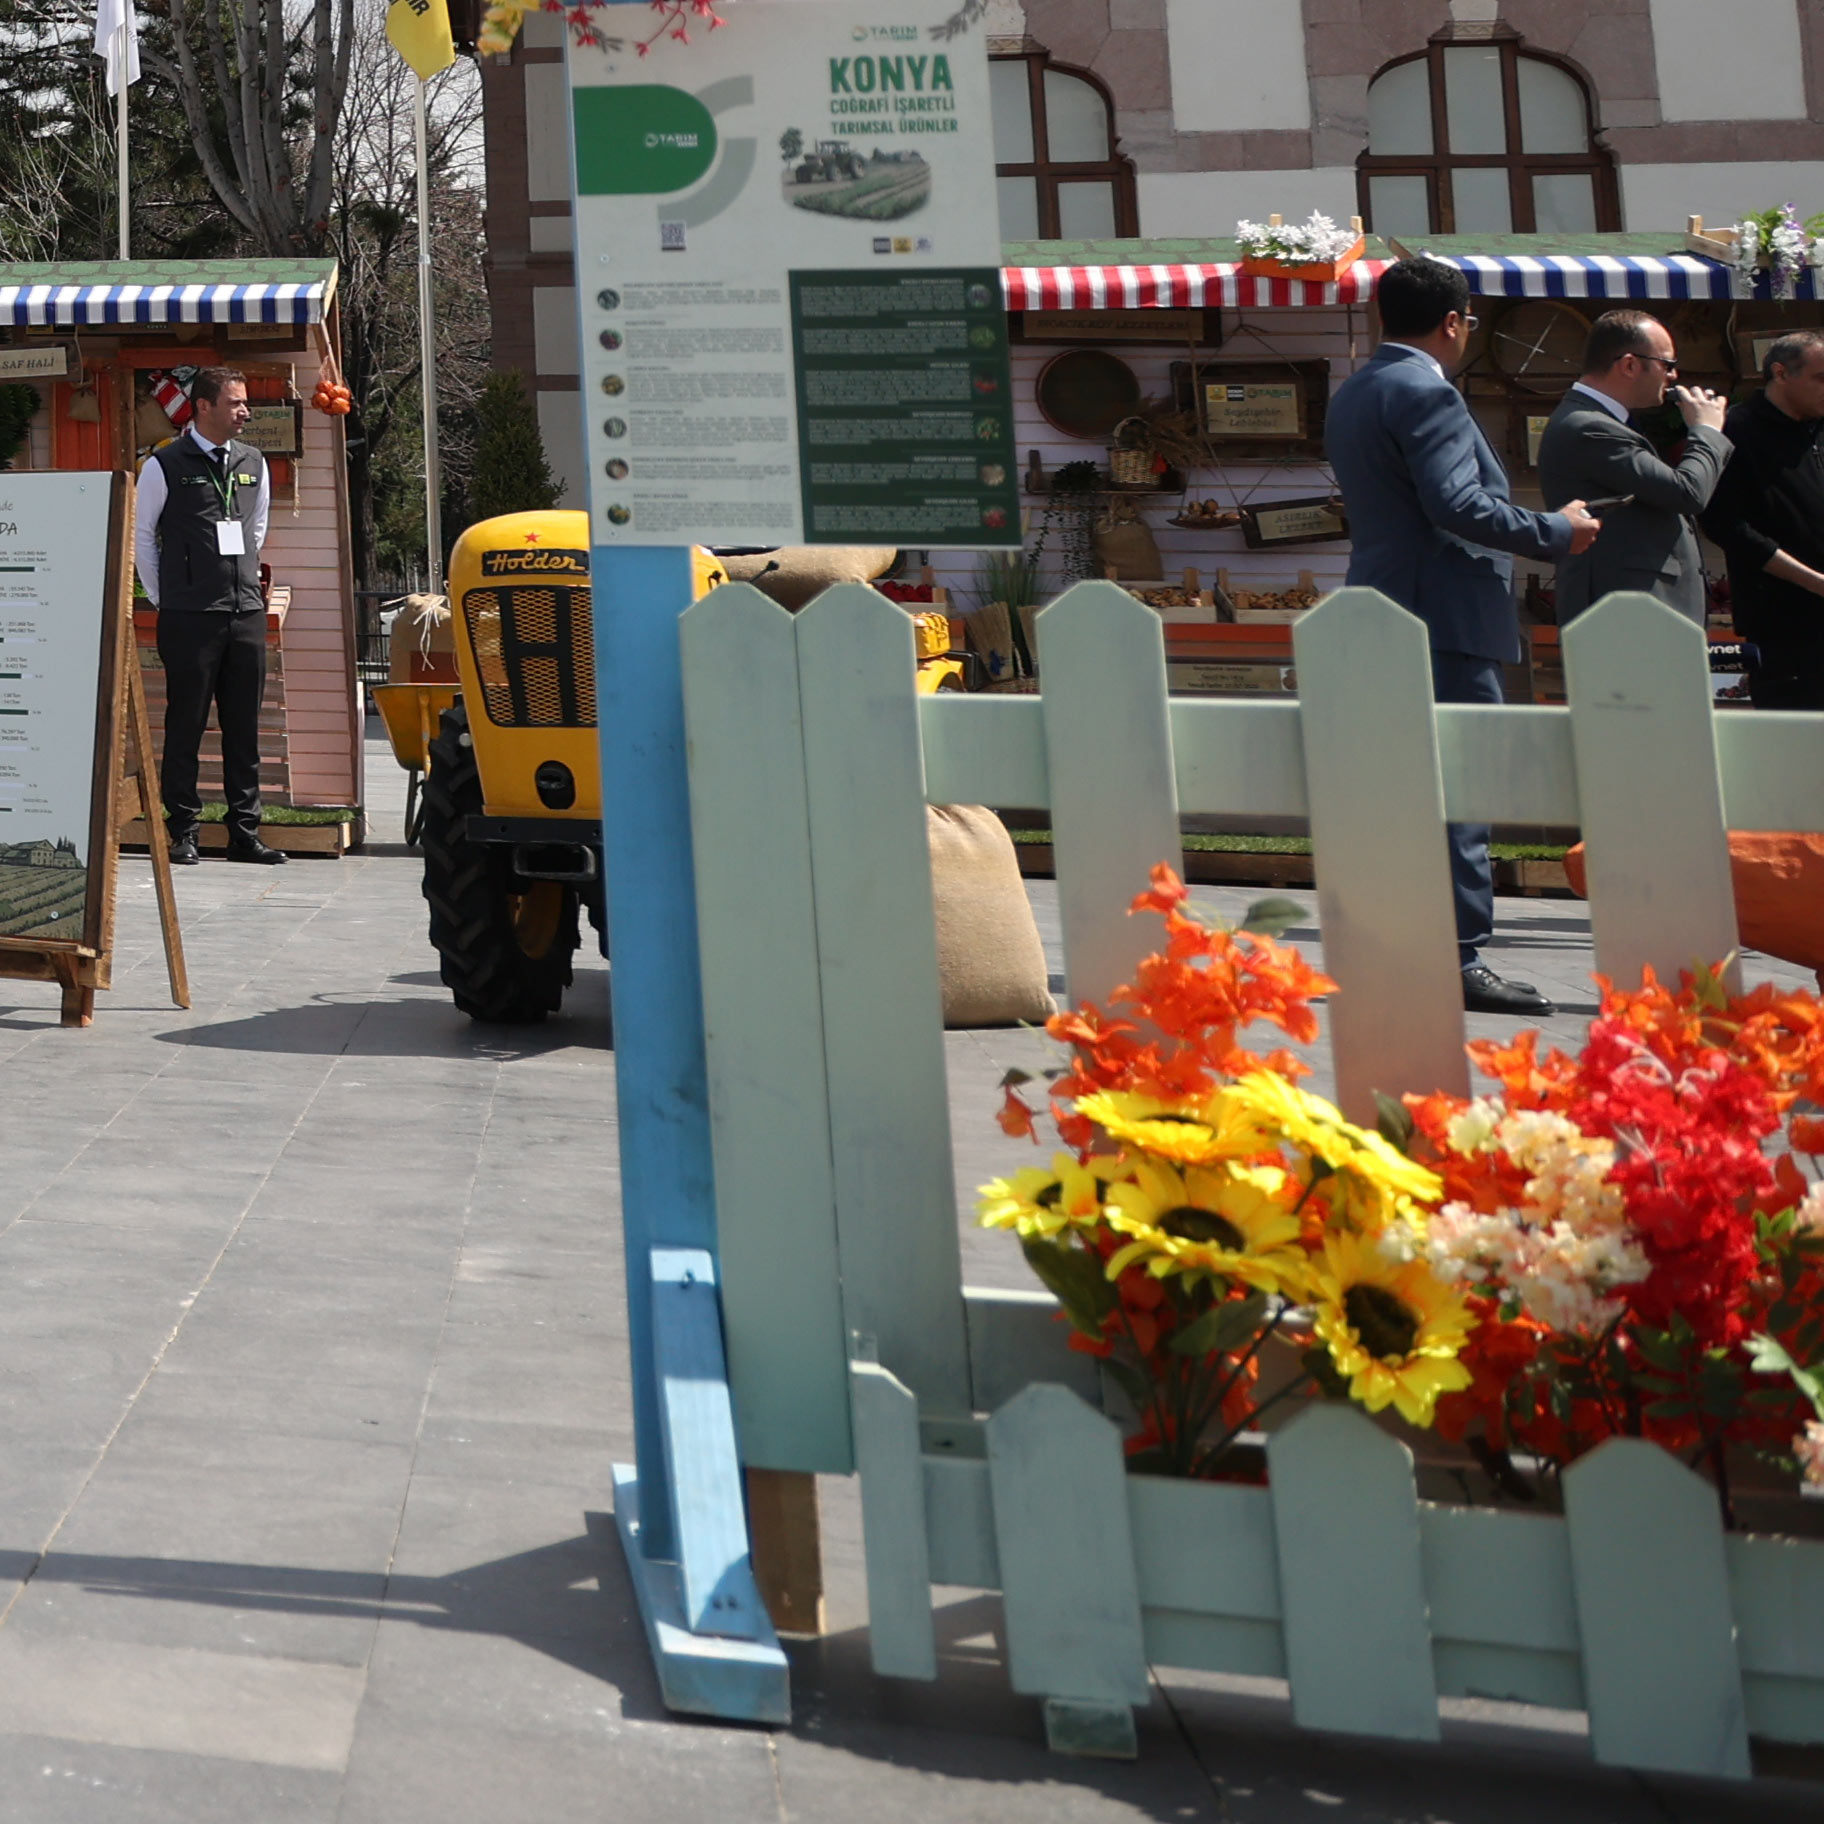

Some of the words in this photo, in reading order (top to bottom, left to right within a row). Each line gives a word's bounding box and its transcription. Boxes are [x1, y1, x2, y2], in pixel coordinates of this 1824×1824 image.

[829, 54, 953, 94] KONYA
[830, 96, 889, 115] COĞRAFİ
[894, 94, 954, 116] İŞARETLİ
[832, 118, 894, 135] TARIMSAL
[899, 116, 958, 133] ÜRÜNLER
[2, 359, 24, 371] SAF
[488, 550, 587, 572] Holder
